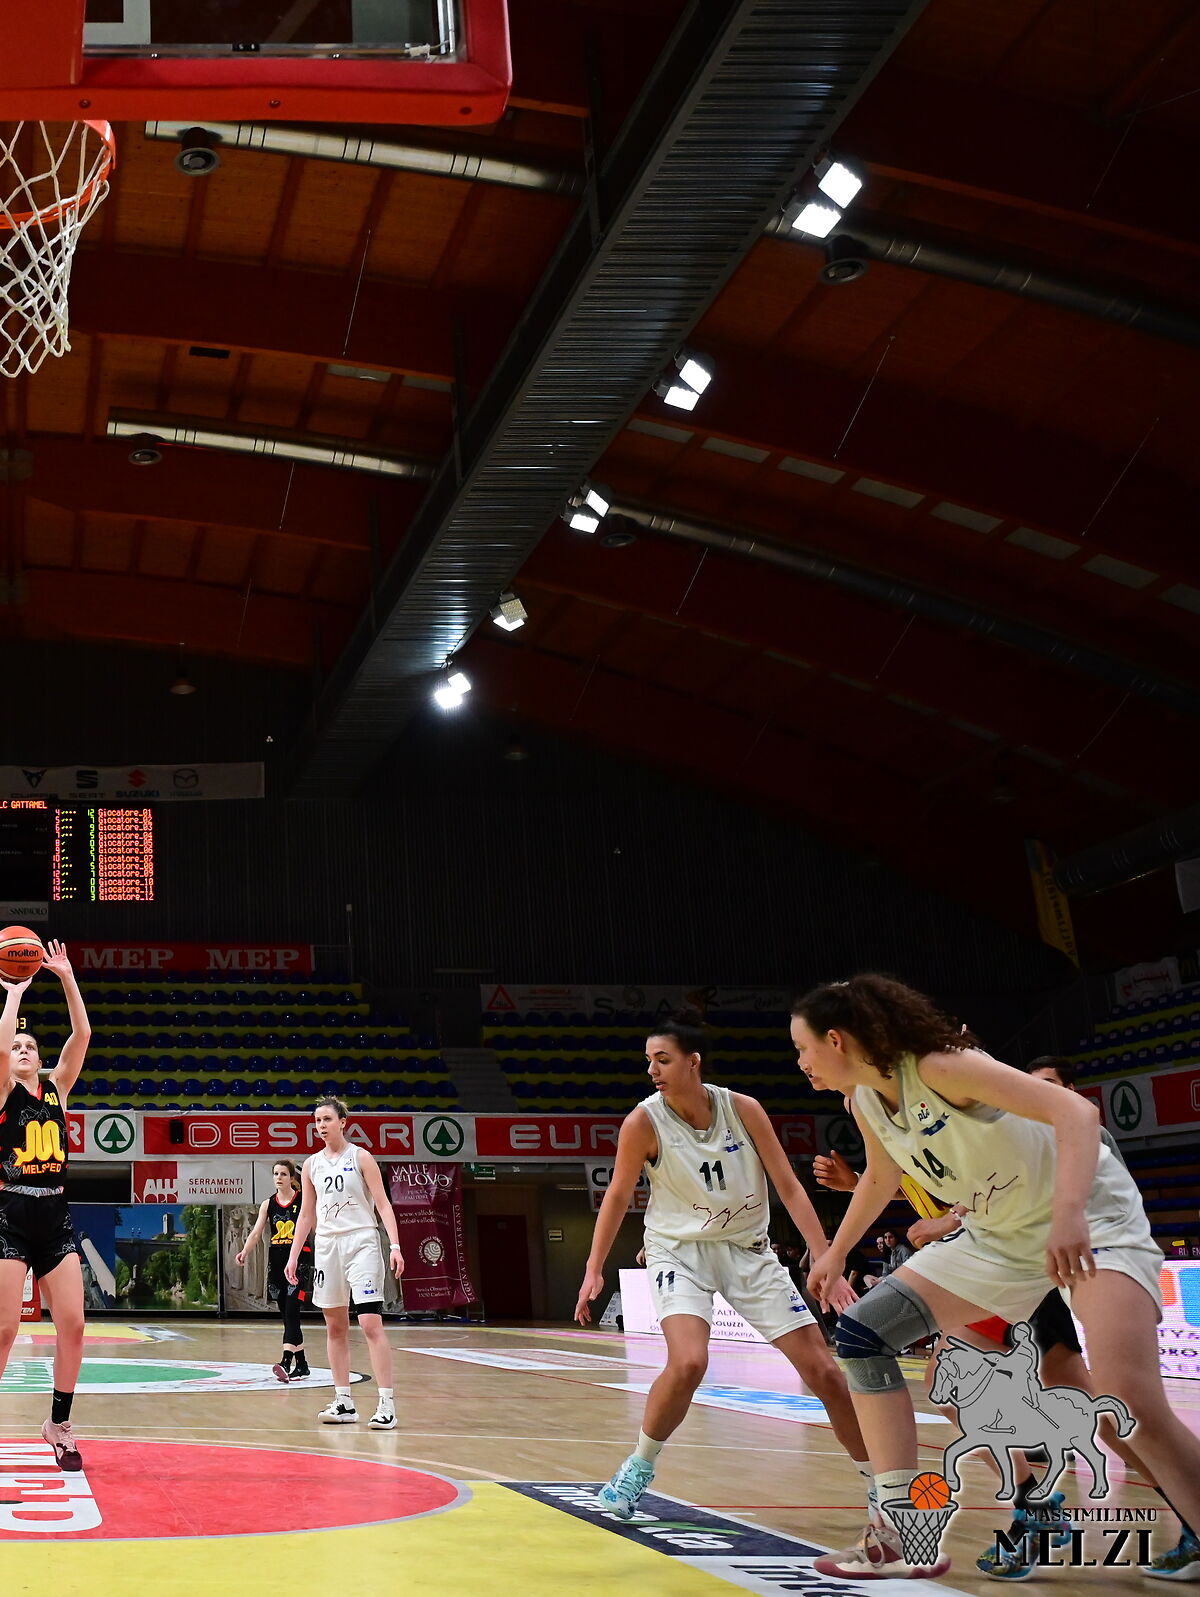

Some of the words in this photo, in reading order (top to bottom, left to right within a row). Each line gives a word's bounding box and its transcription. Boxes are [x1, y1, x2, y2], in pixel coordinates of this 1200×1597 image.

[116, 790, 160, 798] SUZUKI
[10, 800, 48, 809] GATTAMEL
[7, 949, 39, 957] molten
[79, 946, 175, 970] MEP
[205, 947, 301, 970] MEP
[22, 1162, 62, 1175] MELSPED
[391, 1163, 429, 1176] VALLE
[910, 1147, 957, 1188] 14
[188, 1178, 243, 1186] SERRAMENTI
[392, 1175, 409, 1183] DEL
[407, 1173, 451, 1188] LOVO
[699, 1160, 727, 1192] 11
[324, 1174, 344, 1194] 20
[188, 1187, 197, 1195] IN
[199, 1187, 243, 1195] ALLUMINIO
[292, 1205, 297, 1213] 7
[454, 1204, 464, 1247] MARANO
[458, 1252, 464, 1262] DI
[655, 1270, 676, 1296] 11
